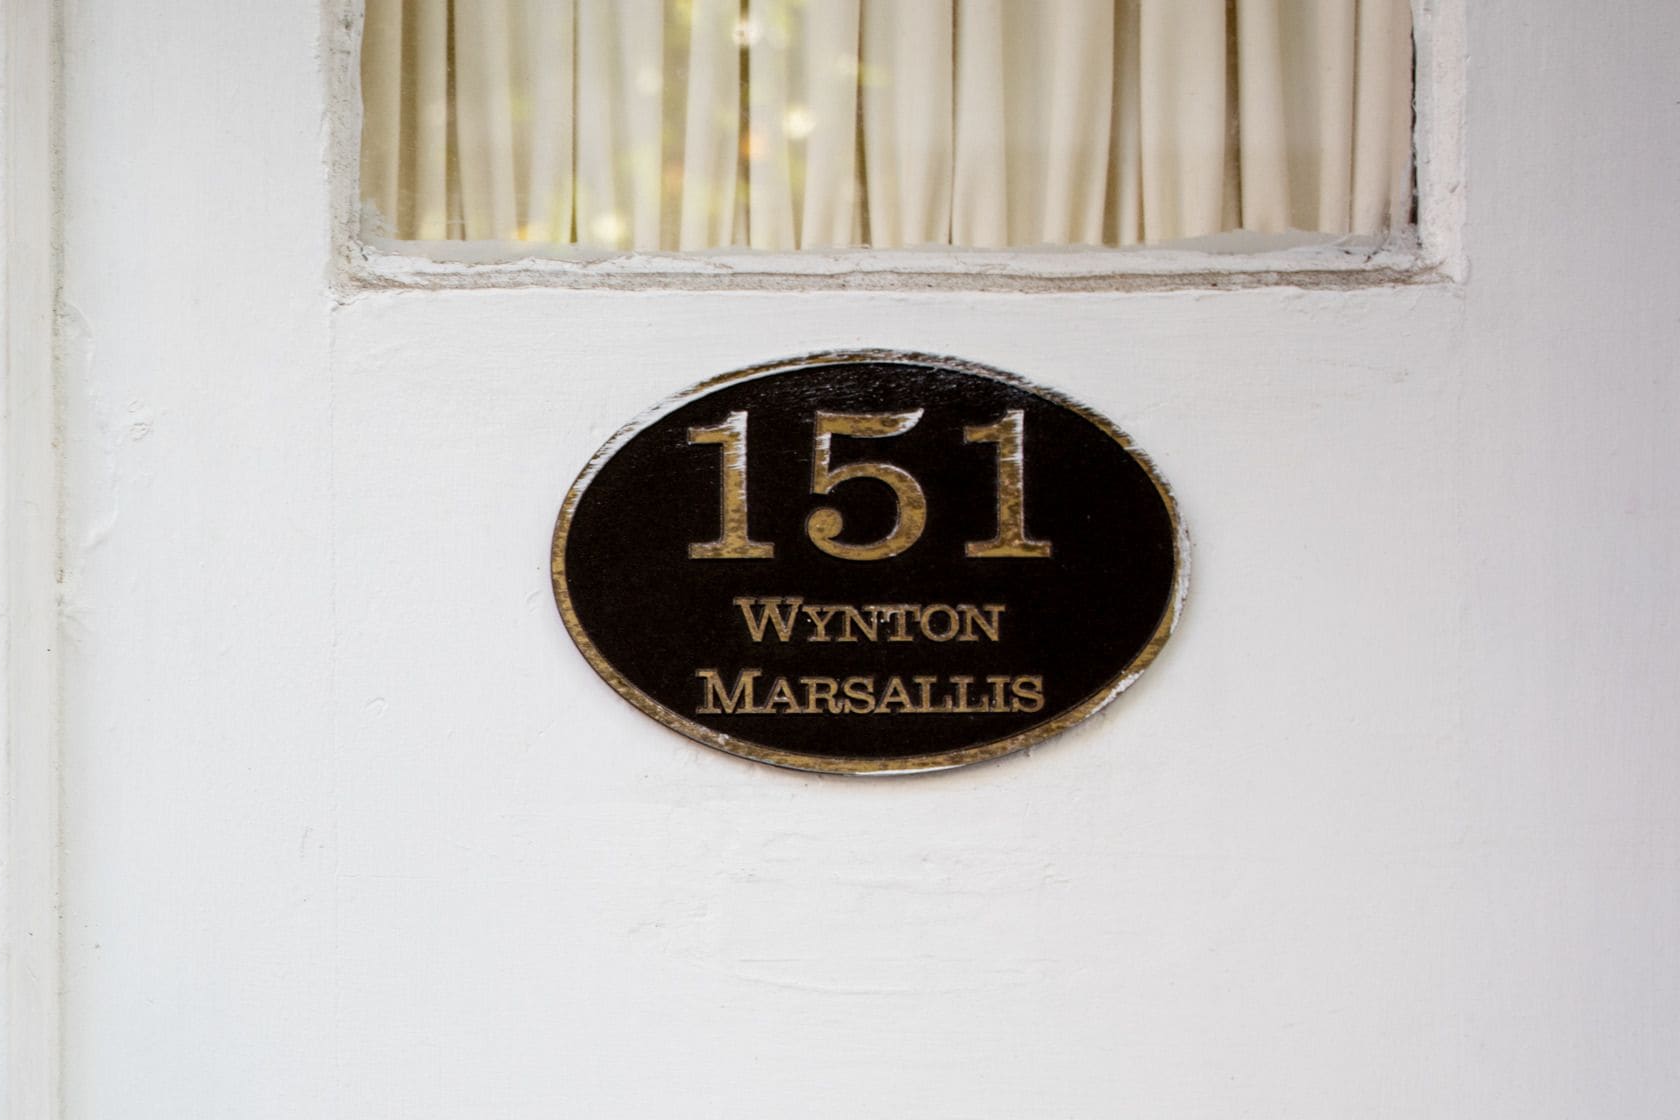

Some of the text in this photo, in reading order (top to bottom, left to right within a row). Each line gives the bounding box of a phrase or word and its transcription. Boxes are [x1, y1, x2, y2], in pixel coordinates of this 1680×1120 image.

[686, 410, 1053, 561] 151
[733, 596, 1006, 643] WYNTON
[696, 668, 1046, 714] MARSALLIS
